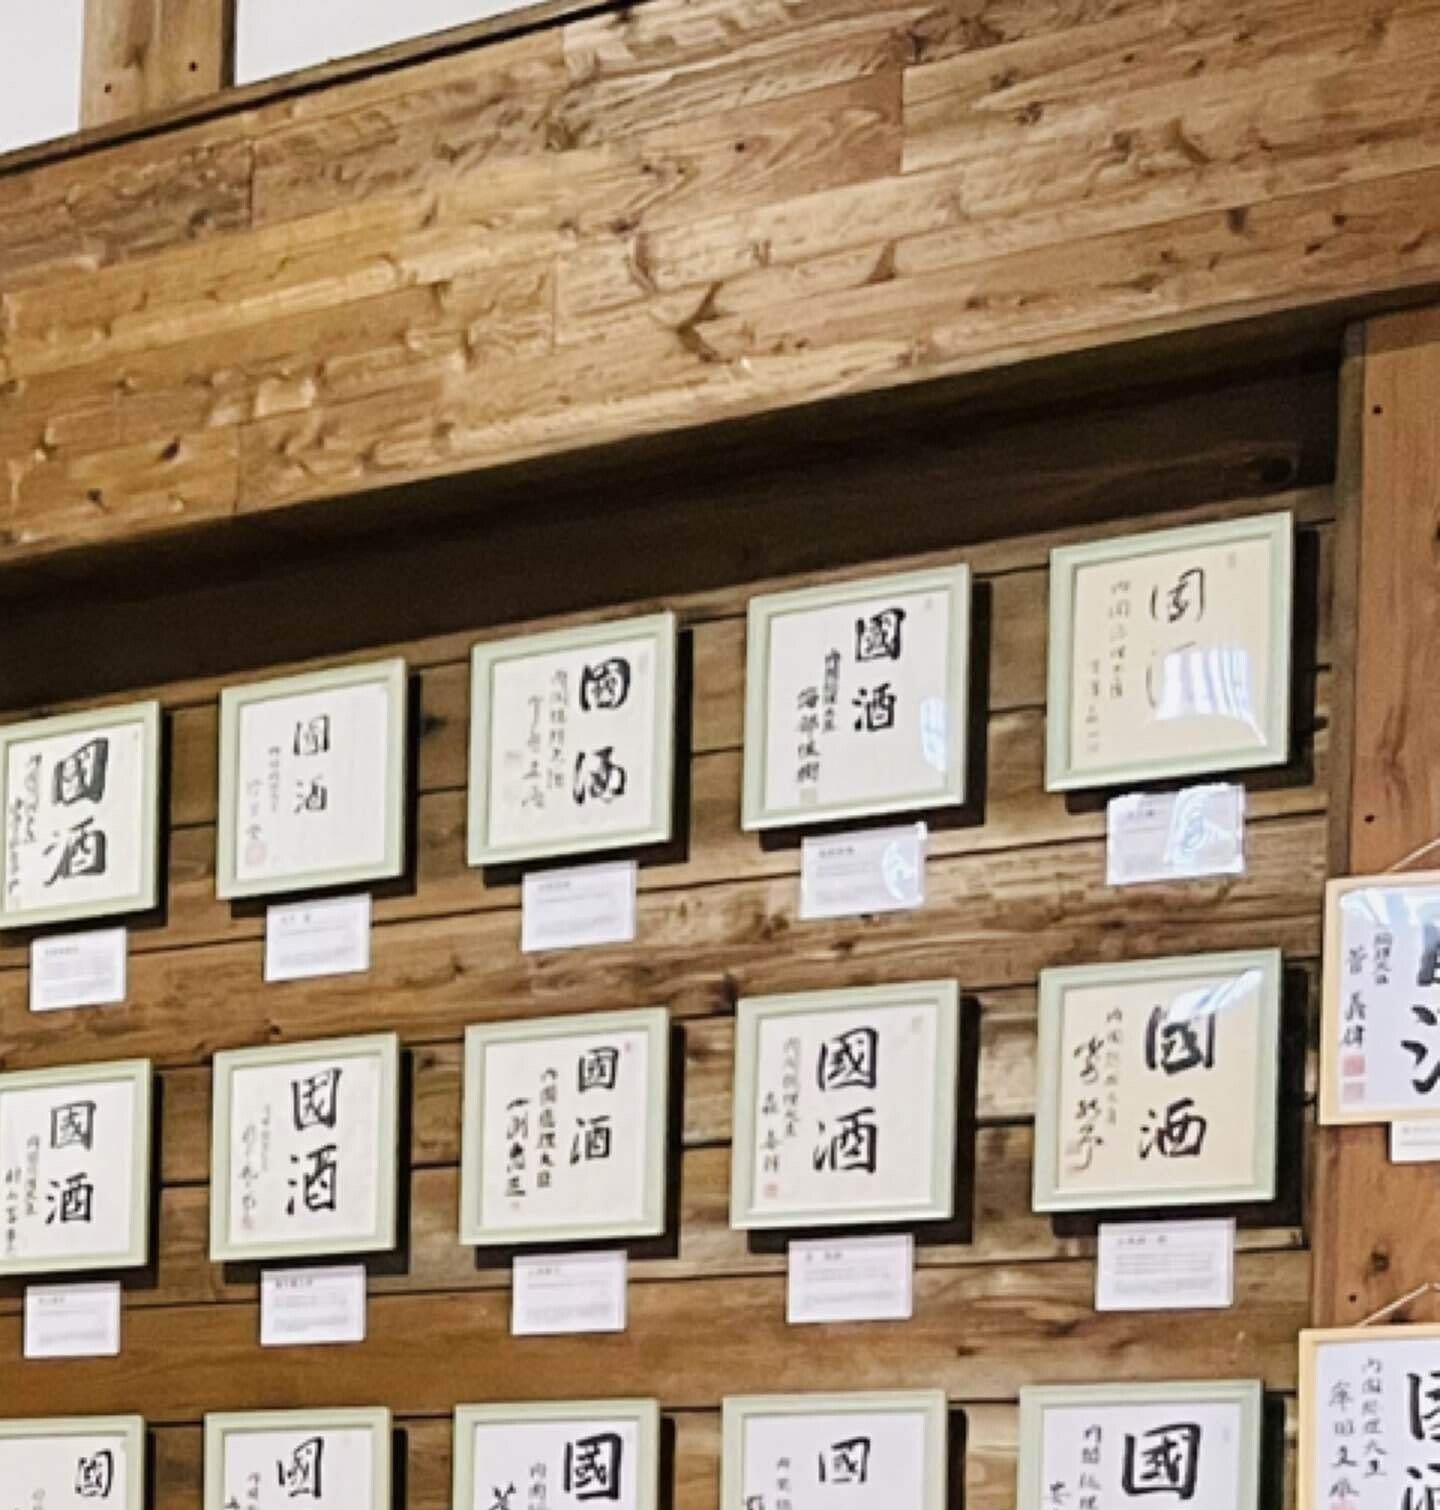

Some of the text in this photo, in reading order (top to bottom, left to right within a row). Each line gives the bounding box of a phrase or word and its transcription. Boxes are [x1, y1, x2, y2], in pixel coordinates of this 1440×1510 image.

[852, 608, 906, 732] 國酒
[570, 1046, 620, 1166] 國酒
[813, 1027, 879, 1174] 國酒
